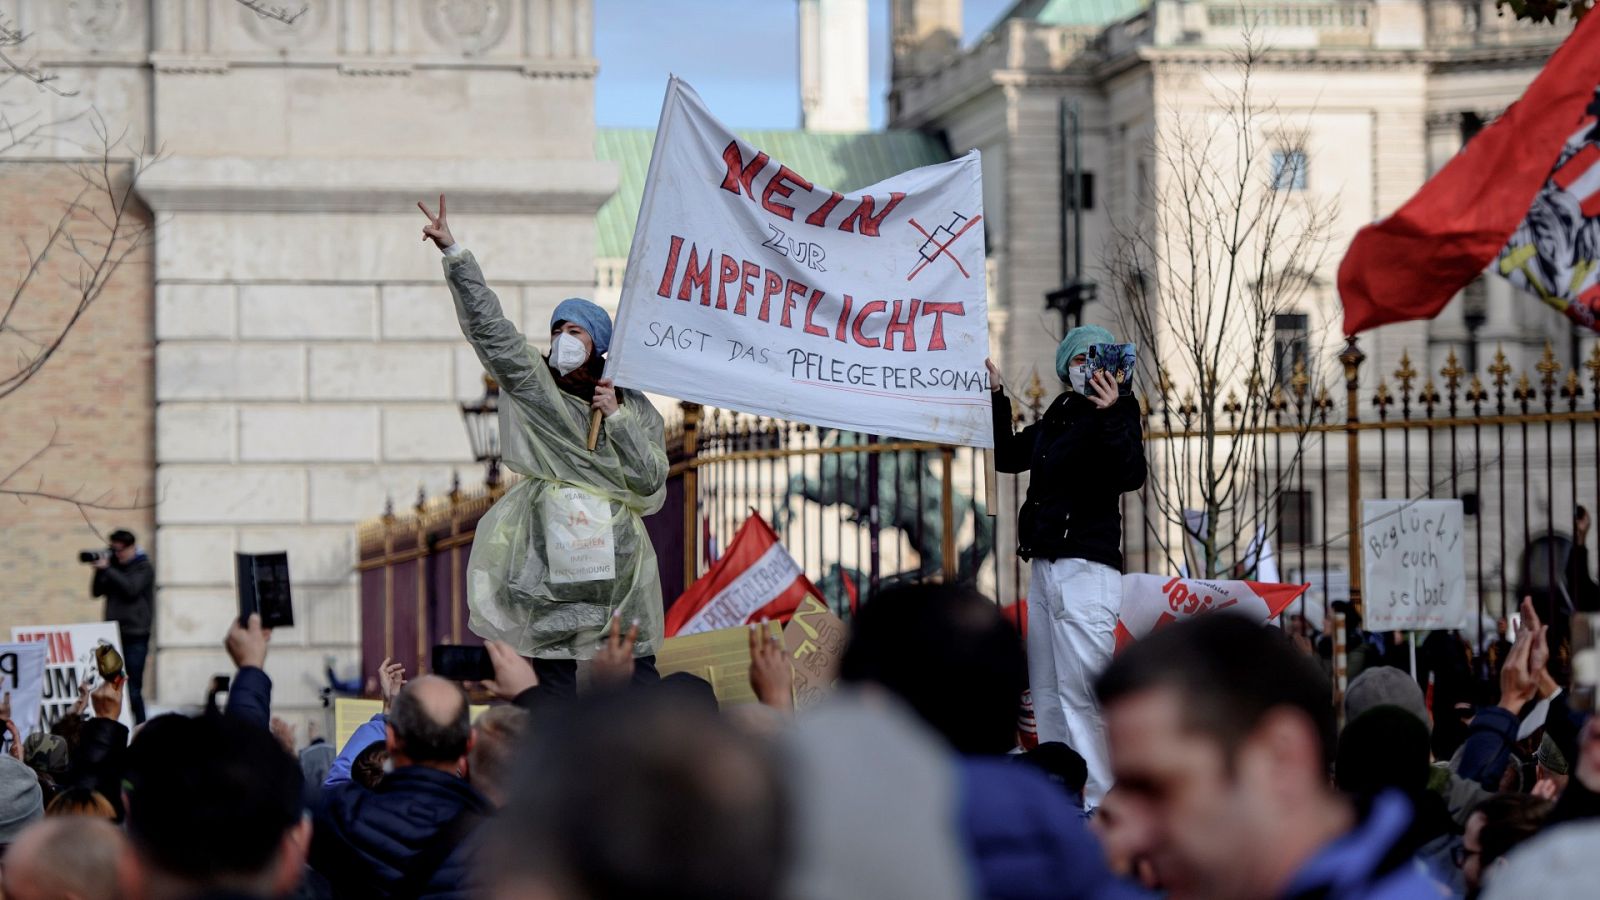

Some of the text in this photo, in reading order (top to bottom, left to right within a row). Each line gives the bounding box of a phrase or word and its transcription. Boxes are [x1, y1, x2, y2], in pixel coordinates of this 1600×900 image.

[719, 139, 907, 238] NEIN
[761, 223, 828, 273] ZUR
[656, 234, 966, 353] IMPFPFLICHT
[643, 320, 993, 393] SAGT DAS PFLEGEPERSONAL
[567, 510, 590, 527] JA
